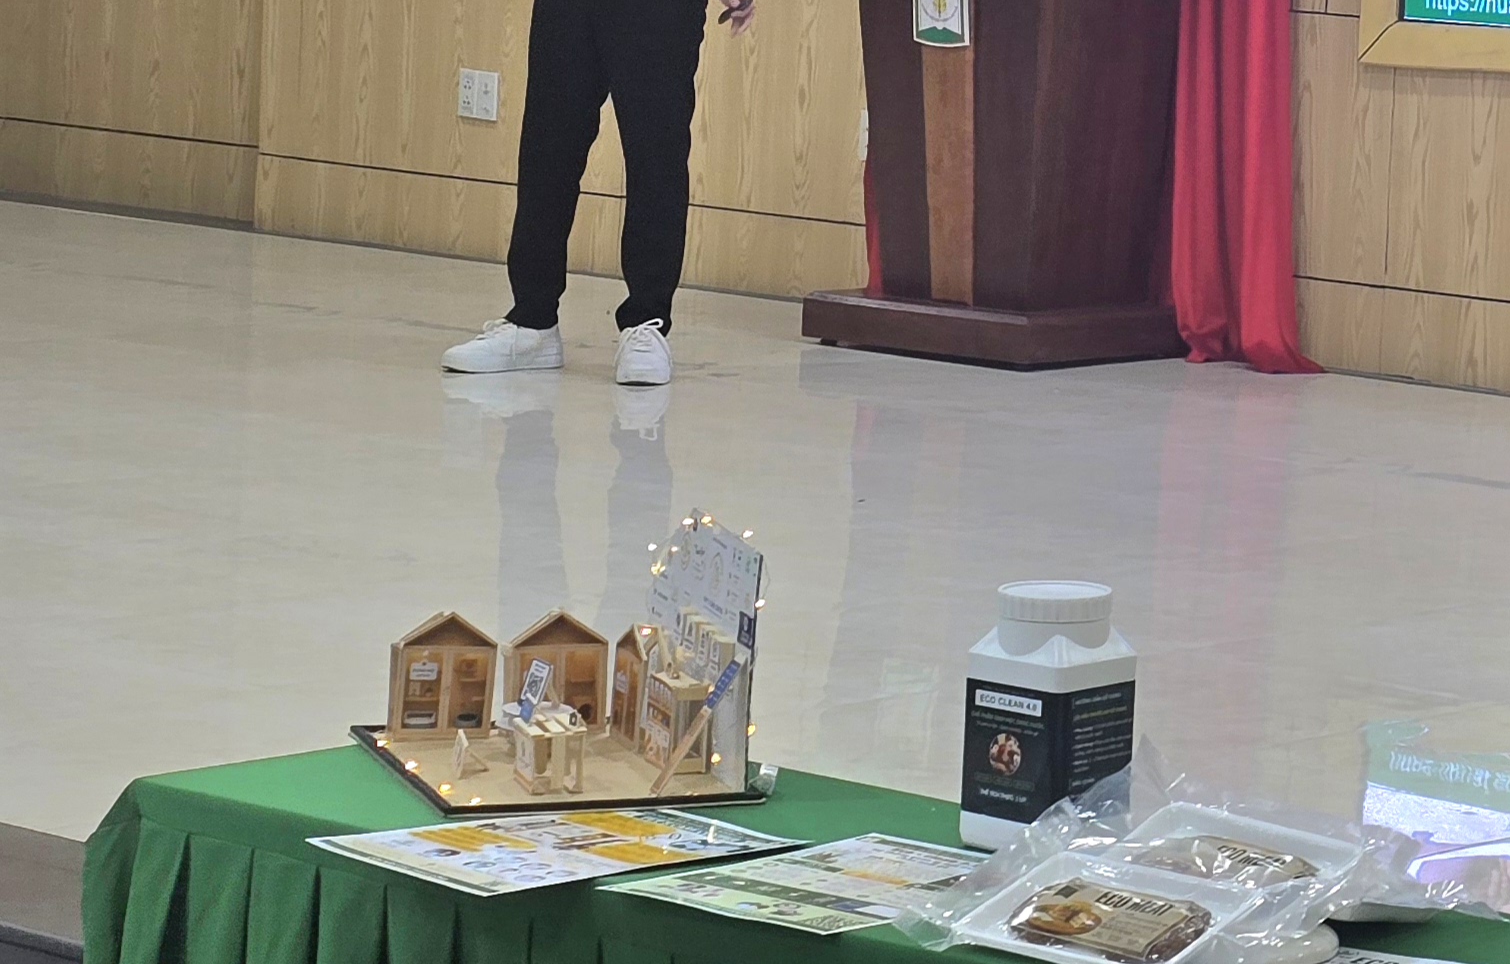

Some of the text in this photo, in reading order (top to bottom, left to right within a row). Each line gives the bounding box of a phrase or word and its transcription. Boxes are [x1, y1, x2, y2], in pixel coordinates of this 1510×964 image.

[980, 693, 996, 704] ECO
[998, 697, 1024, 709] CLEAN
[1094, 890, 1133, 909] ECO
